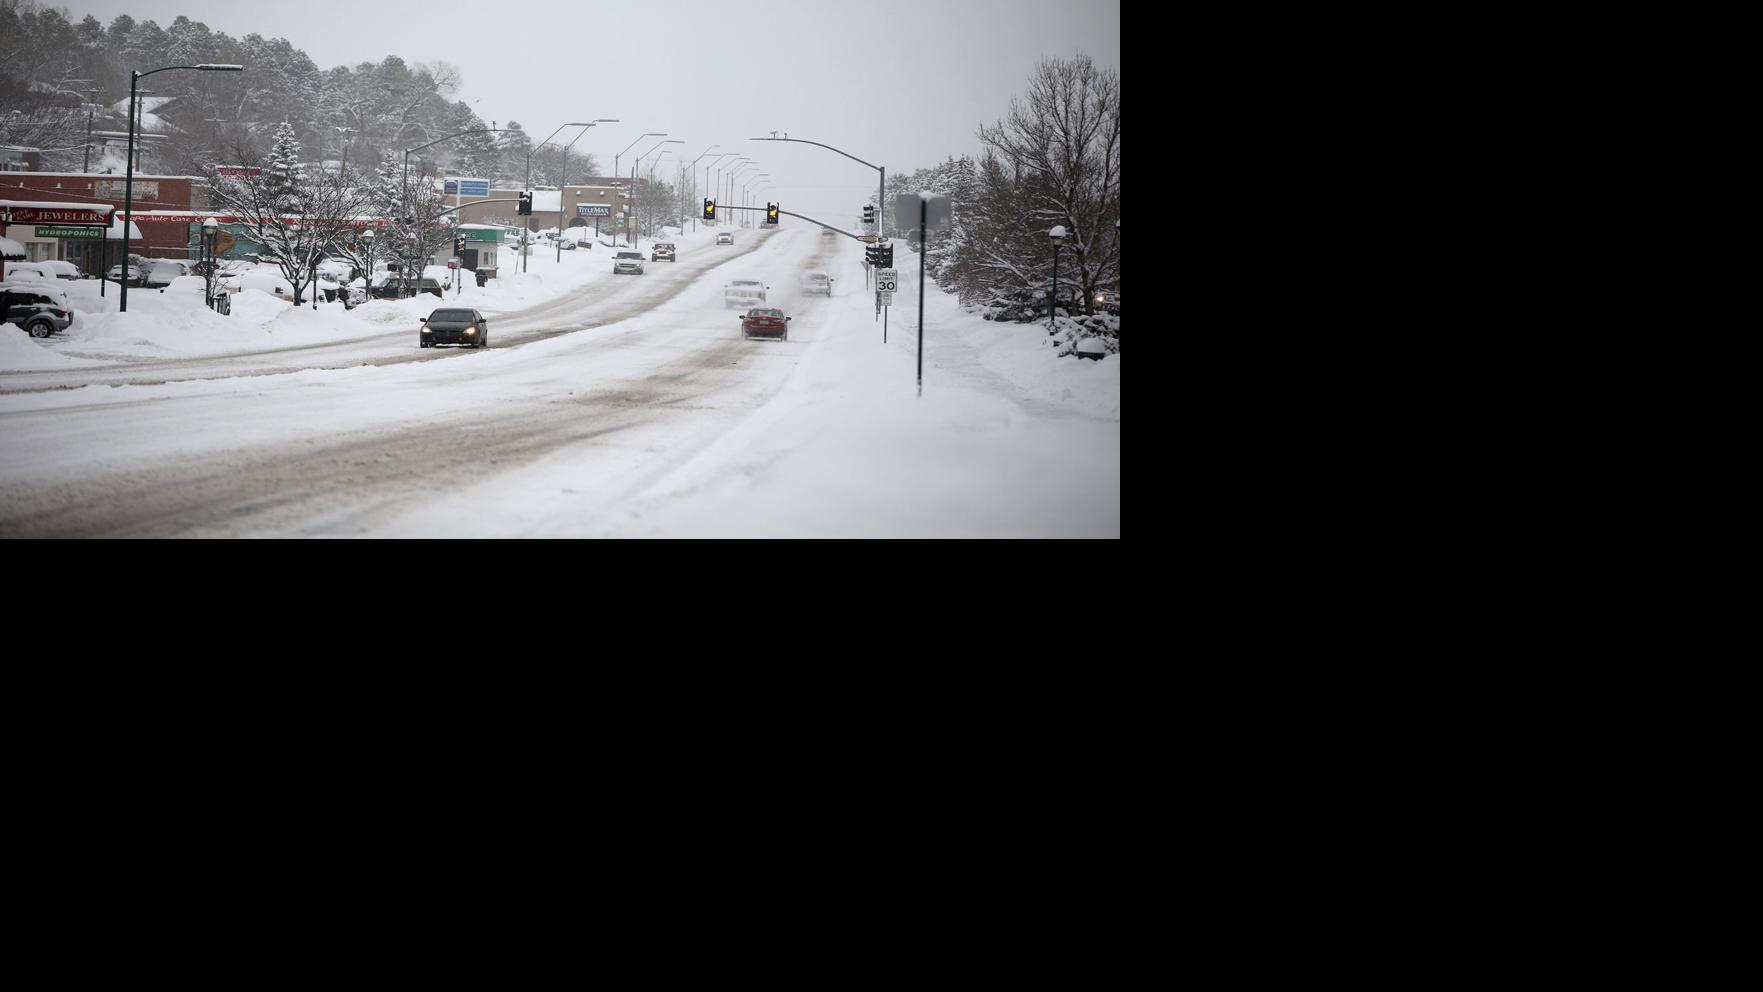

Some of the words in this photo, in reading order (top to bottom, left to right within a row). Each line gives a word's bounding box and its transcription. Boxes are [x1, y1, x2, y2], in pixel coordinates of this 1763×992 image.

[37, 211, 105, 222] JEWELERS
[38, 229, 99, 237] HYDROPONICS
[878, 281, 895, 291] 30
